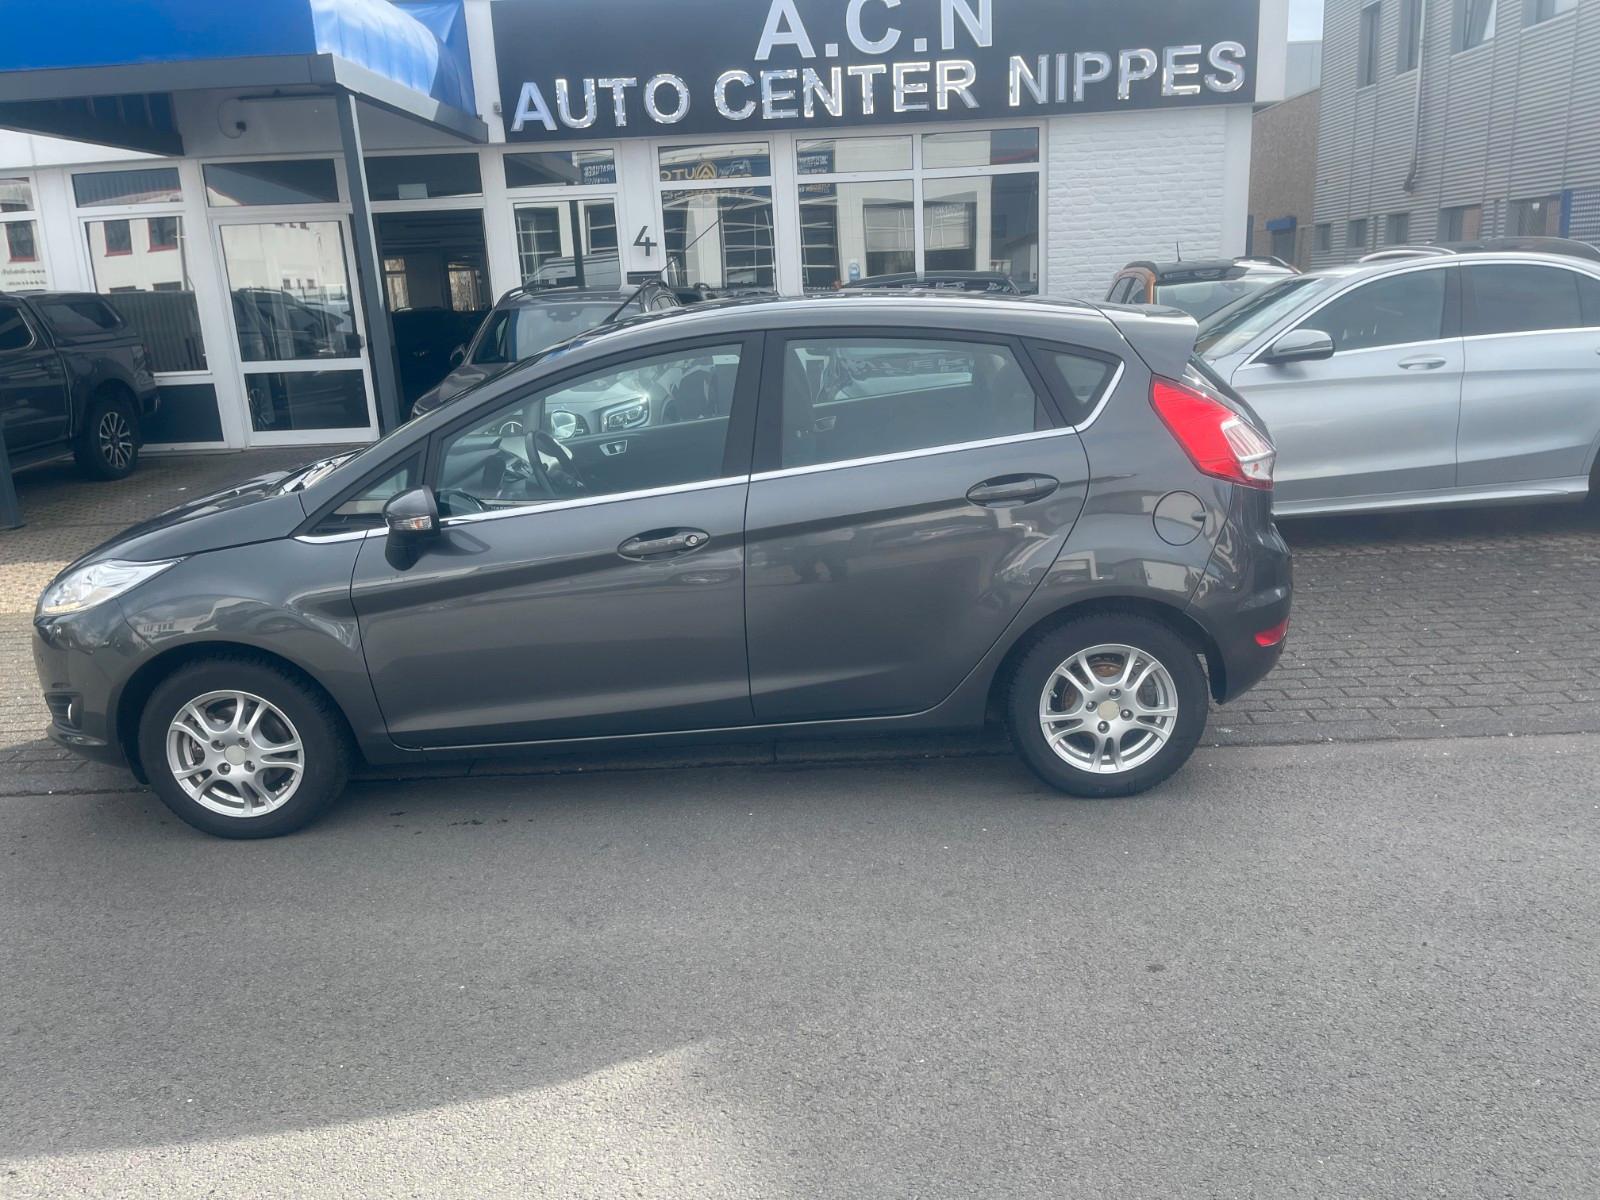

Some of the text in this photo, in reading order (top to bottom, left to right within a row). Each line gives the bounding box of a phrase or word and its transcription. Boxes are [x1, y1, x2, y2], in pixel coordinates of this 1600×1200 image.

[512, 42, 1246, 131] AUTO CENTER NIPPES
[633, 225, 657, 256] 4
